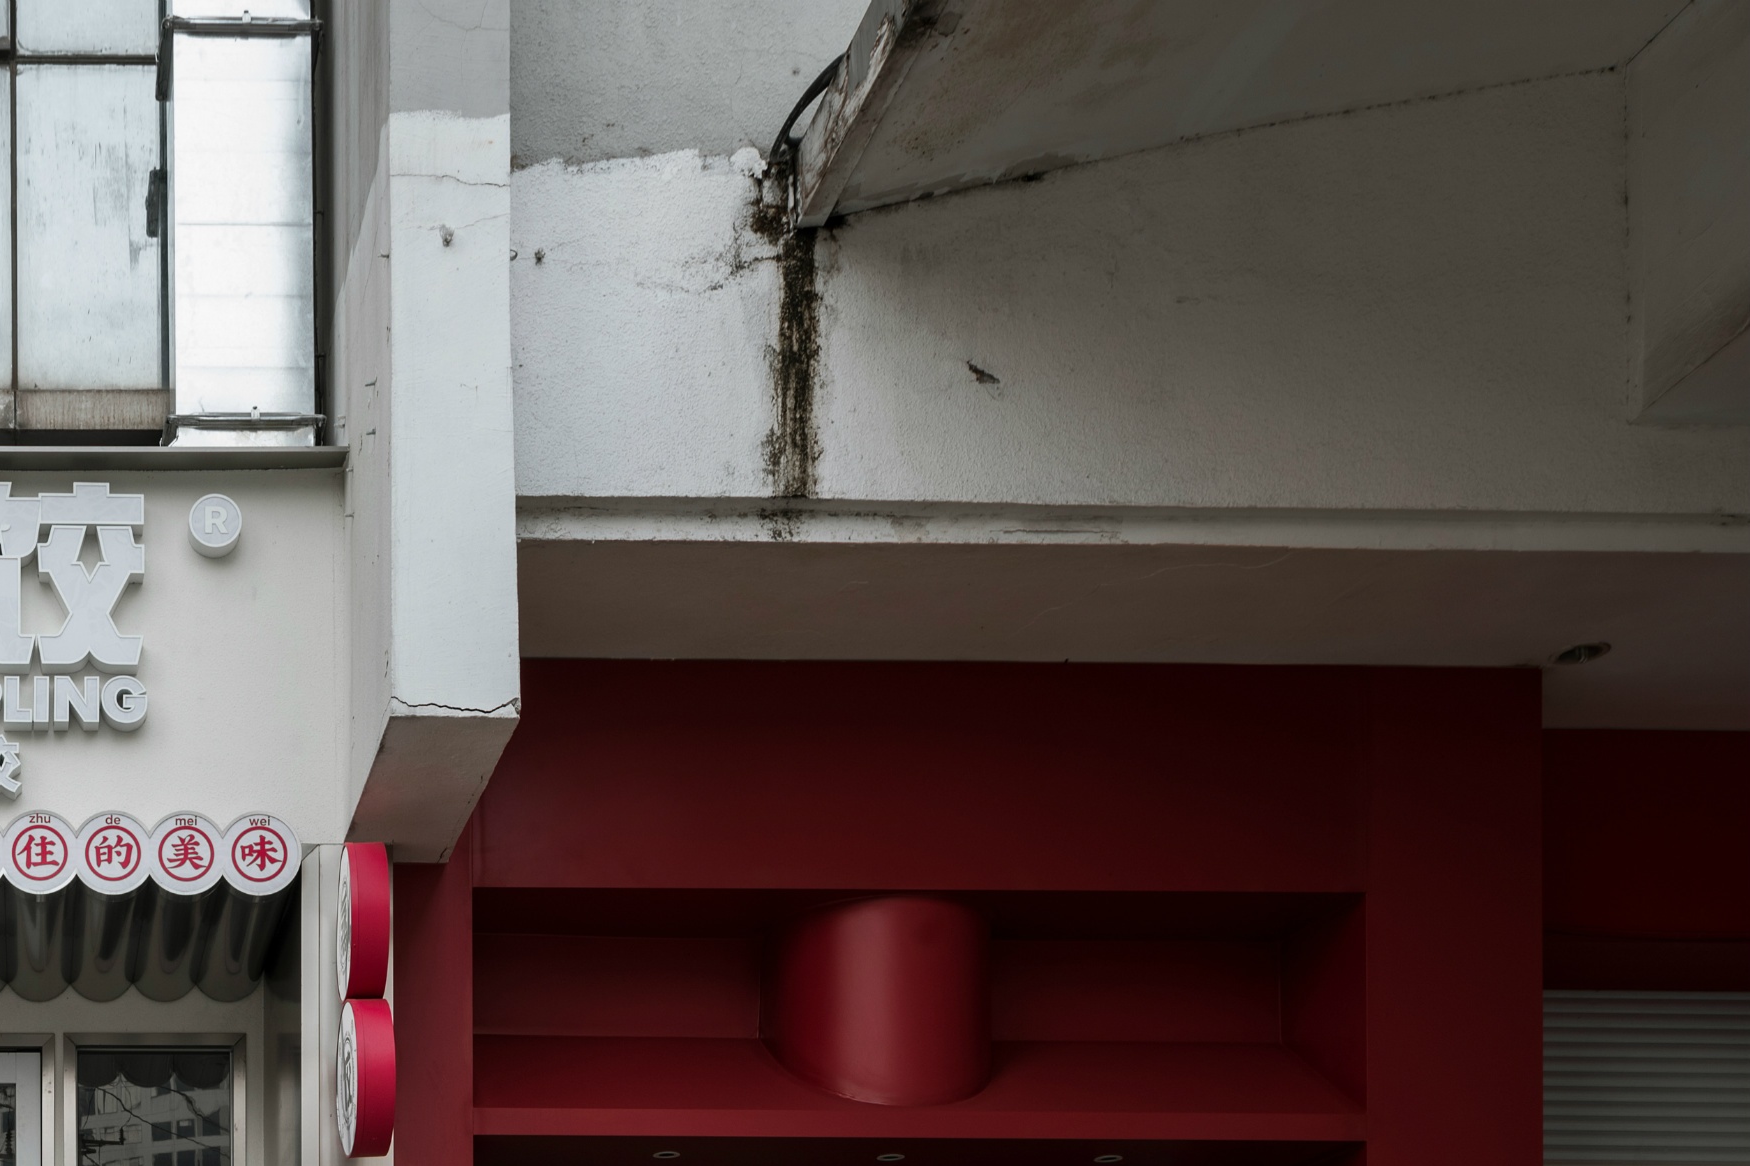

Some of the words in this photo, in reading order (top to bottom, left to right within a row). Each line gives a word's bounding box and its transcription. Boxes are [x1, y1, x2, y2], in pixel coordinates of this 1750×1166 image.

[29, 814, 51, 824] zhu
[105, 815, 121, 825] de
[175, 816, 198, 826] mei
[249, 816, 271, 826] wei
